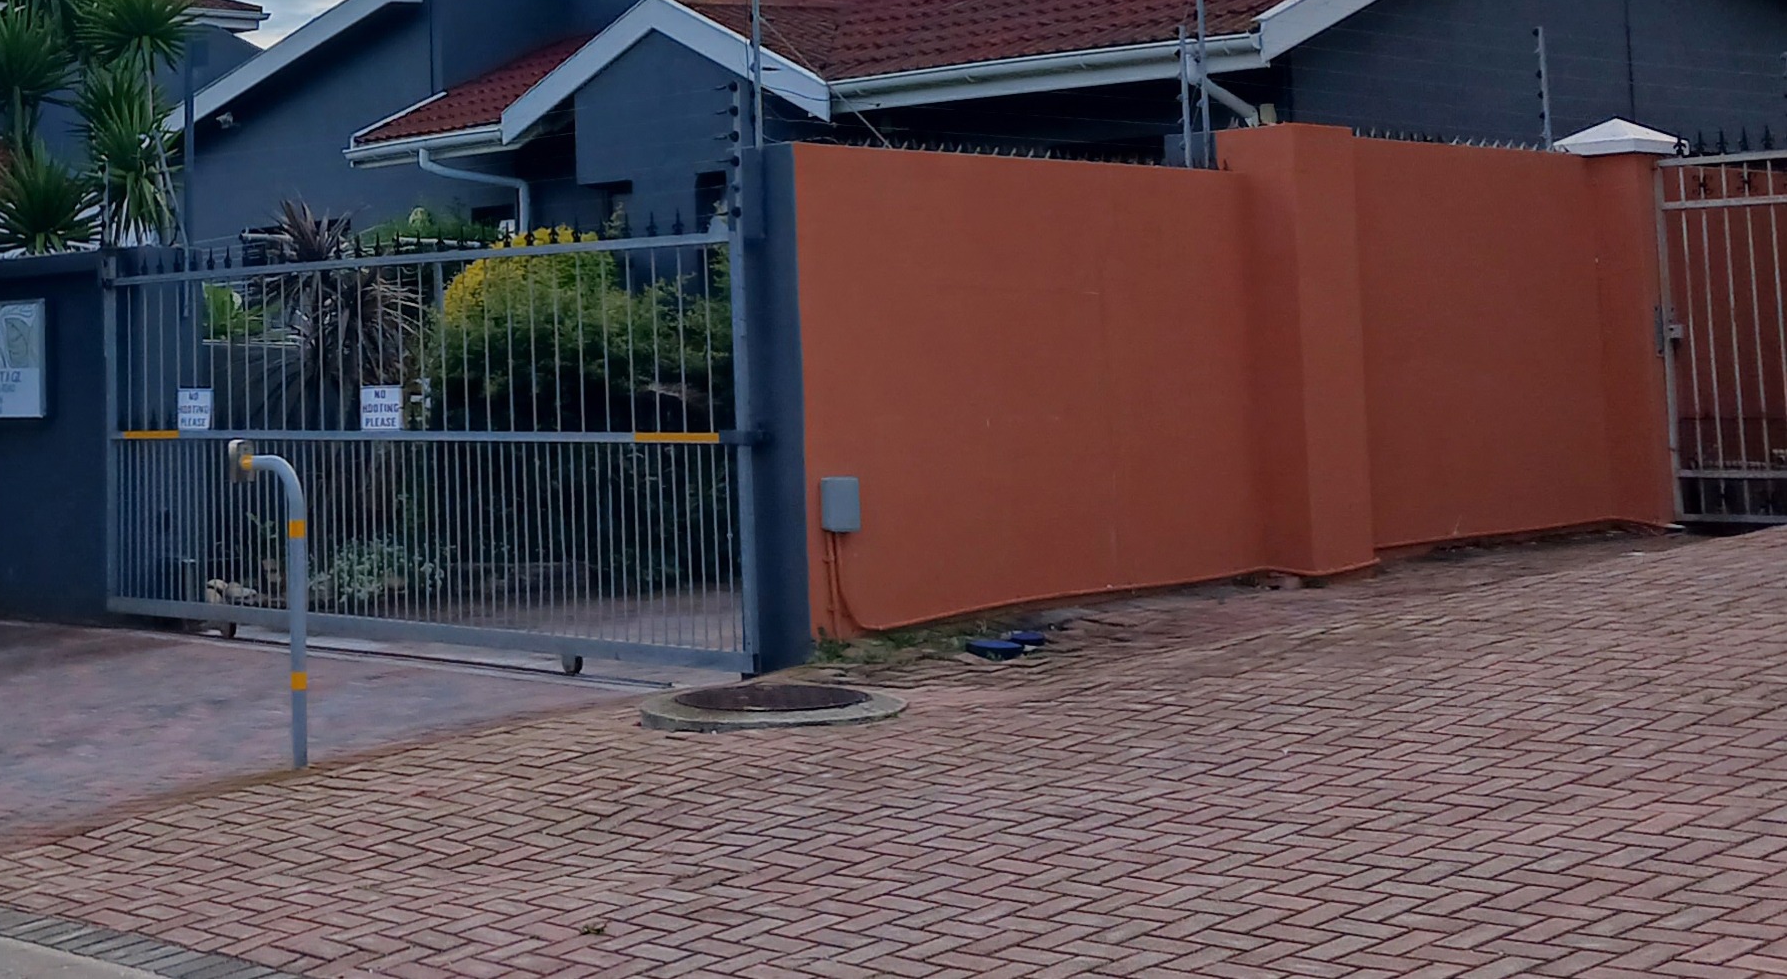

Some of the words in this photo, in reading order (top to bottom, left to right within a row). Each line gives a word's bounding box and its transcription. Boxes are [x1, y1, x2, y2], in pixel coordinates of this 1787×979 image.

[188, 391, 199, 401] NO
[374, 389, 386, 399] NO
[362, 403, 399, 413] HOOTING
[181, 417, 206, 427] PLEASE
[365, 417, 396, 427] PLEASE
